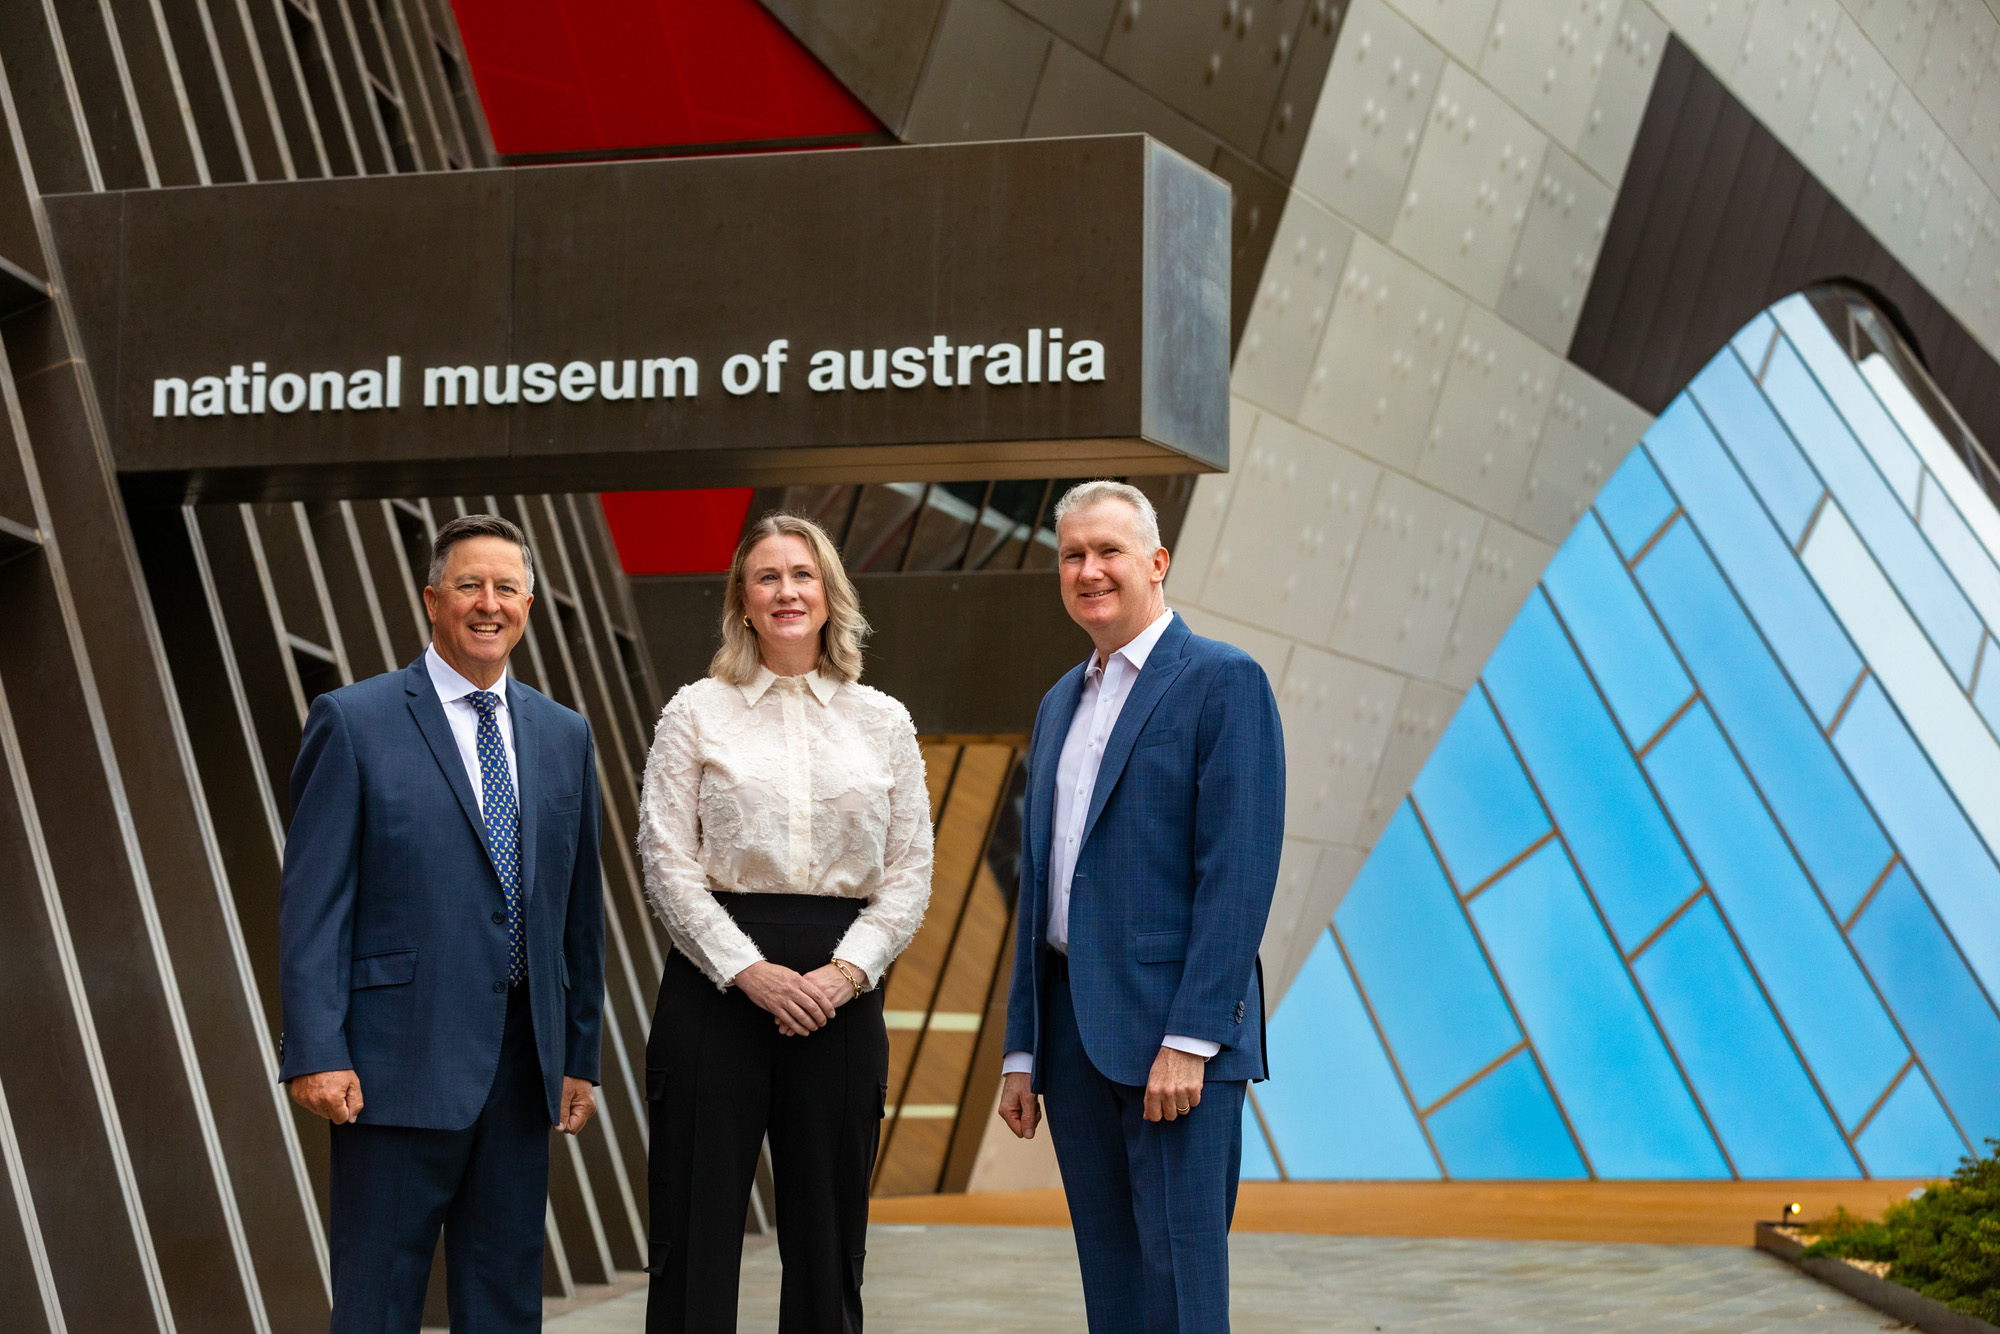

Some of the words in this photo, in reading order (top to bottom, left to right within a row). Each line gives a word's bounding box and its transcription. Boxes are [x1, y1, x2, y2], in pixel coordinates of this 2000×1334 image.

[153, 355, 401, 418] national
[424, 356, 698, 407] museum
[721, 339, 789, 396] of
[808, 327, 1106, 393] australia
